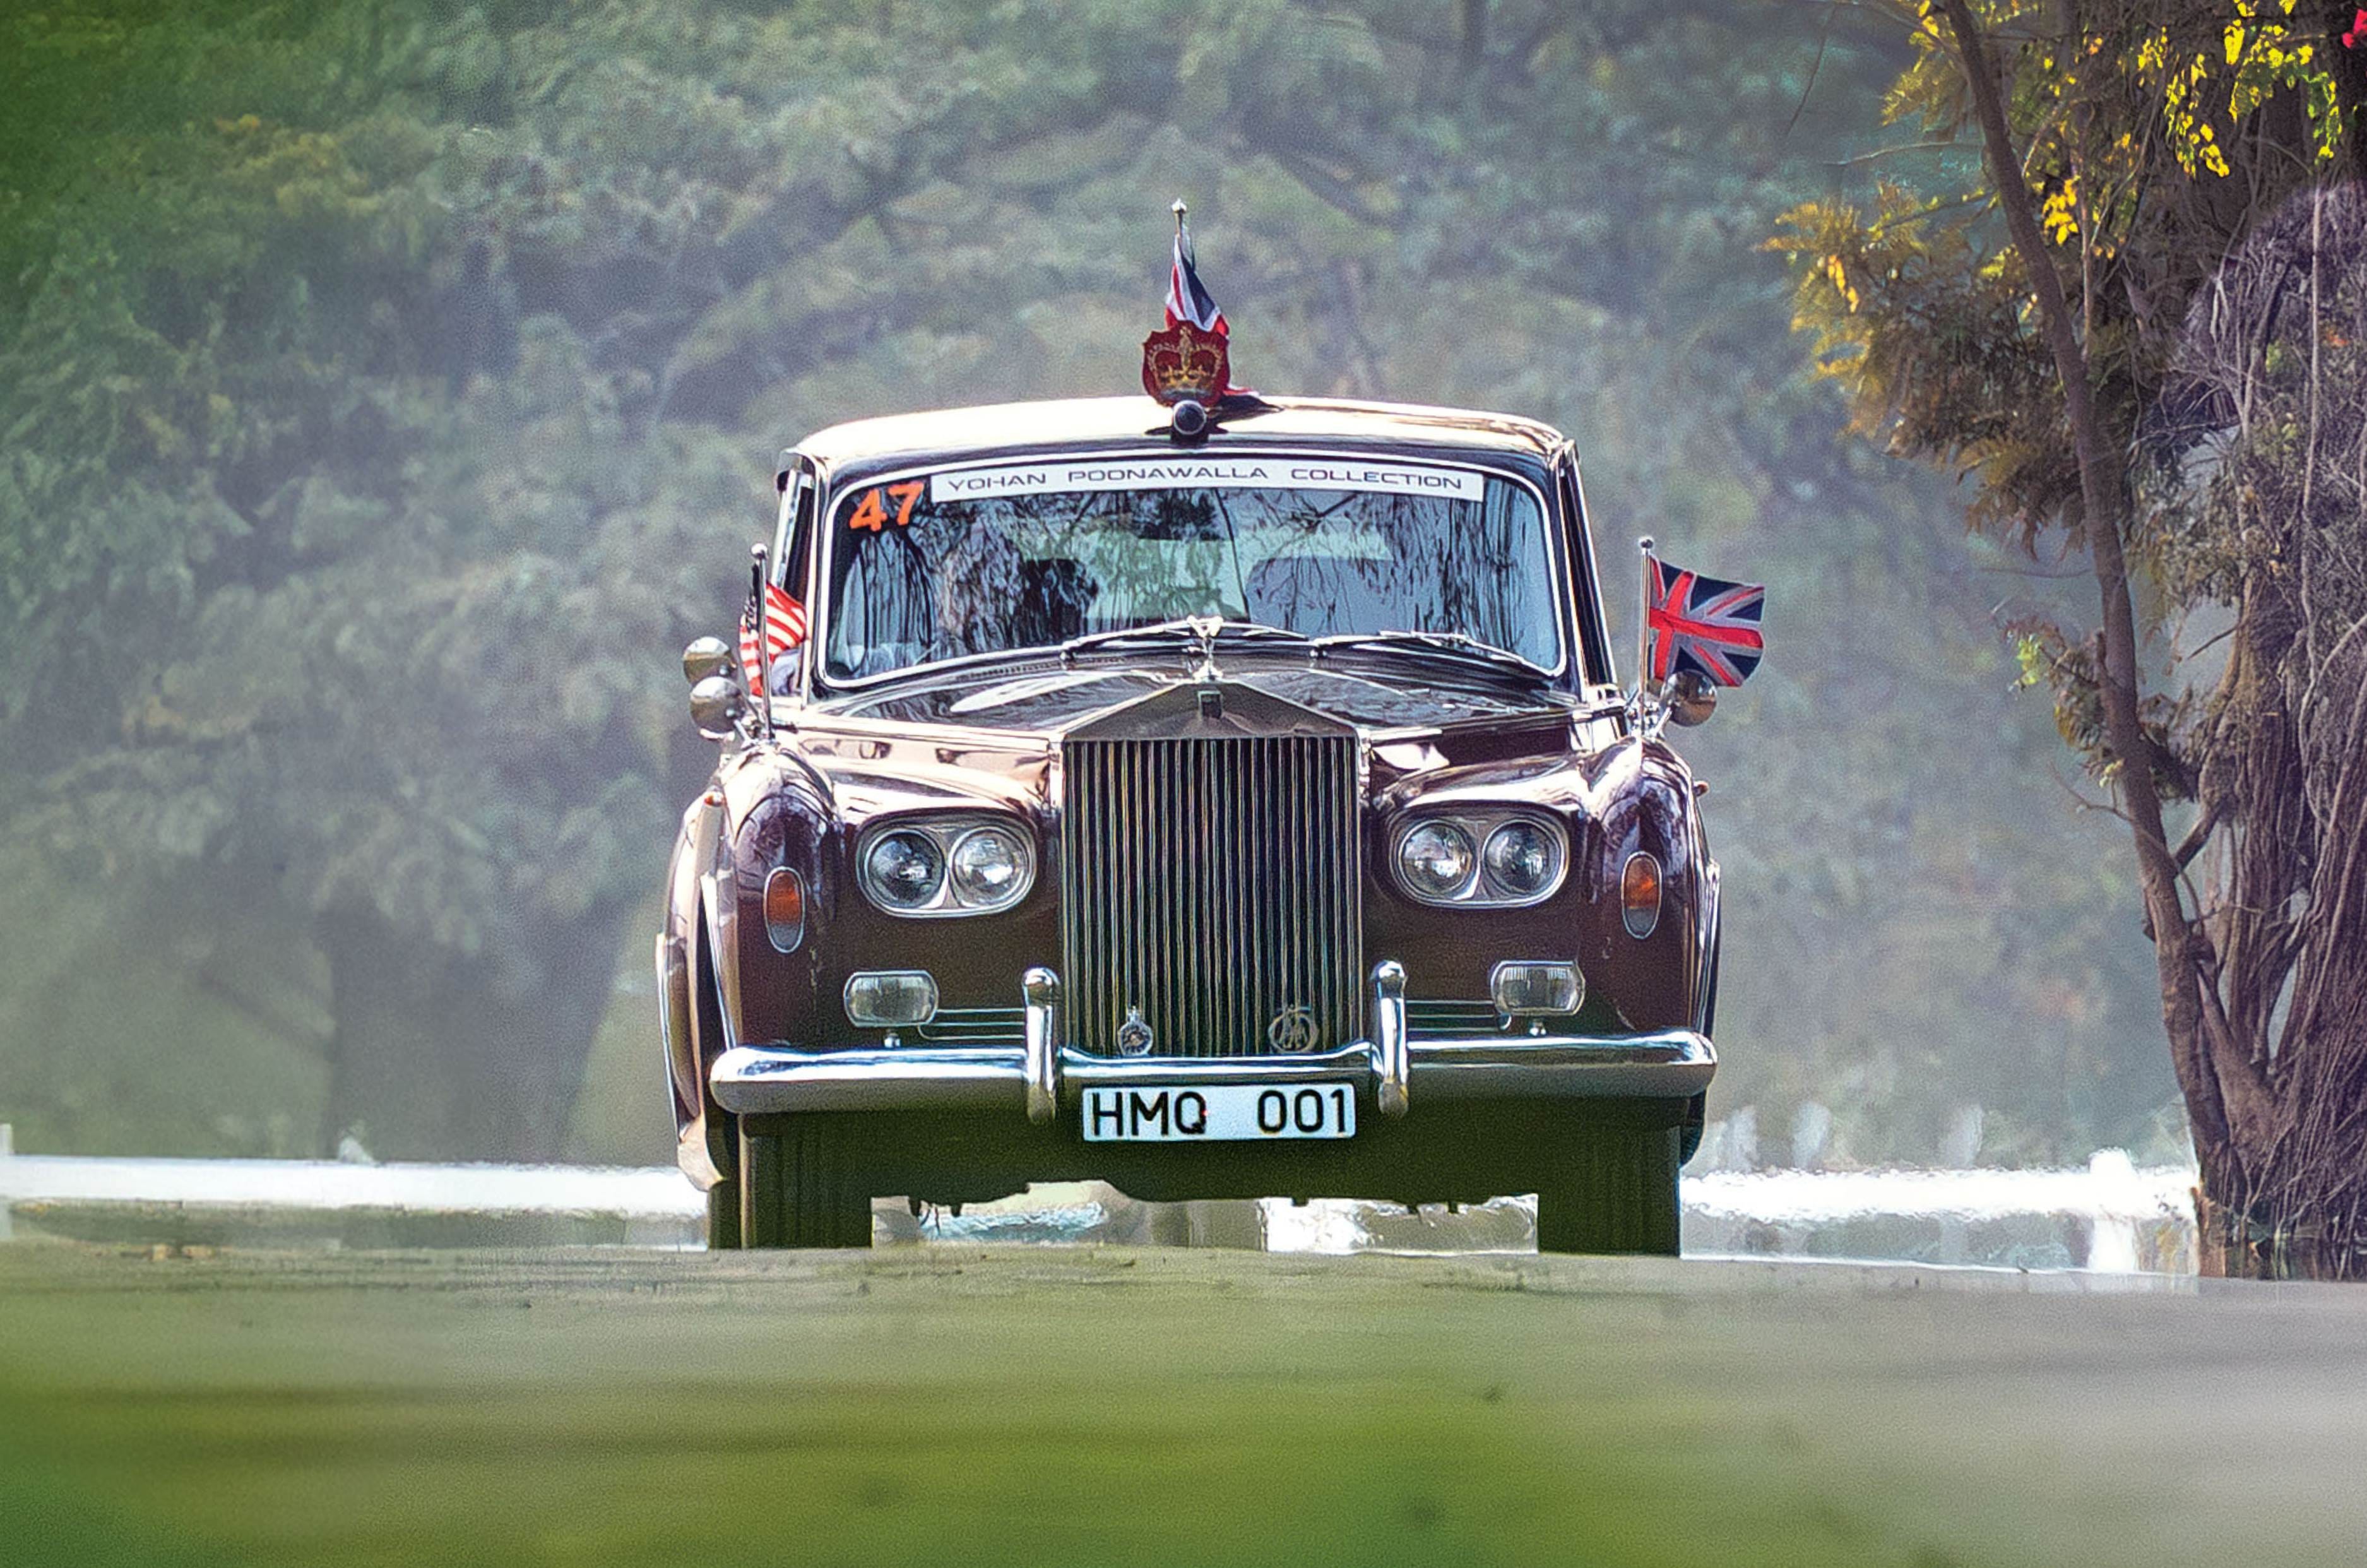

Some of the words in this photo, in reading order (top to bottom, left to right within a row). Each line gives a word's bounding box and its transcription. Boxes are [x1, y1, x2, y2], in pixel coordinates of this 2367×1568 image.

[948, 472, 1047, 492] YOHAN
[1068, 466, 1269, 484] POONAWALLA
[1291, 468, 1462, 490] COLLECTION
[850, 482, 924, 532] 47
[1092, 1091, 1207, 1136] HMQ
[1257, 1088, 1345, 1134] 001
